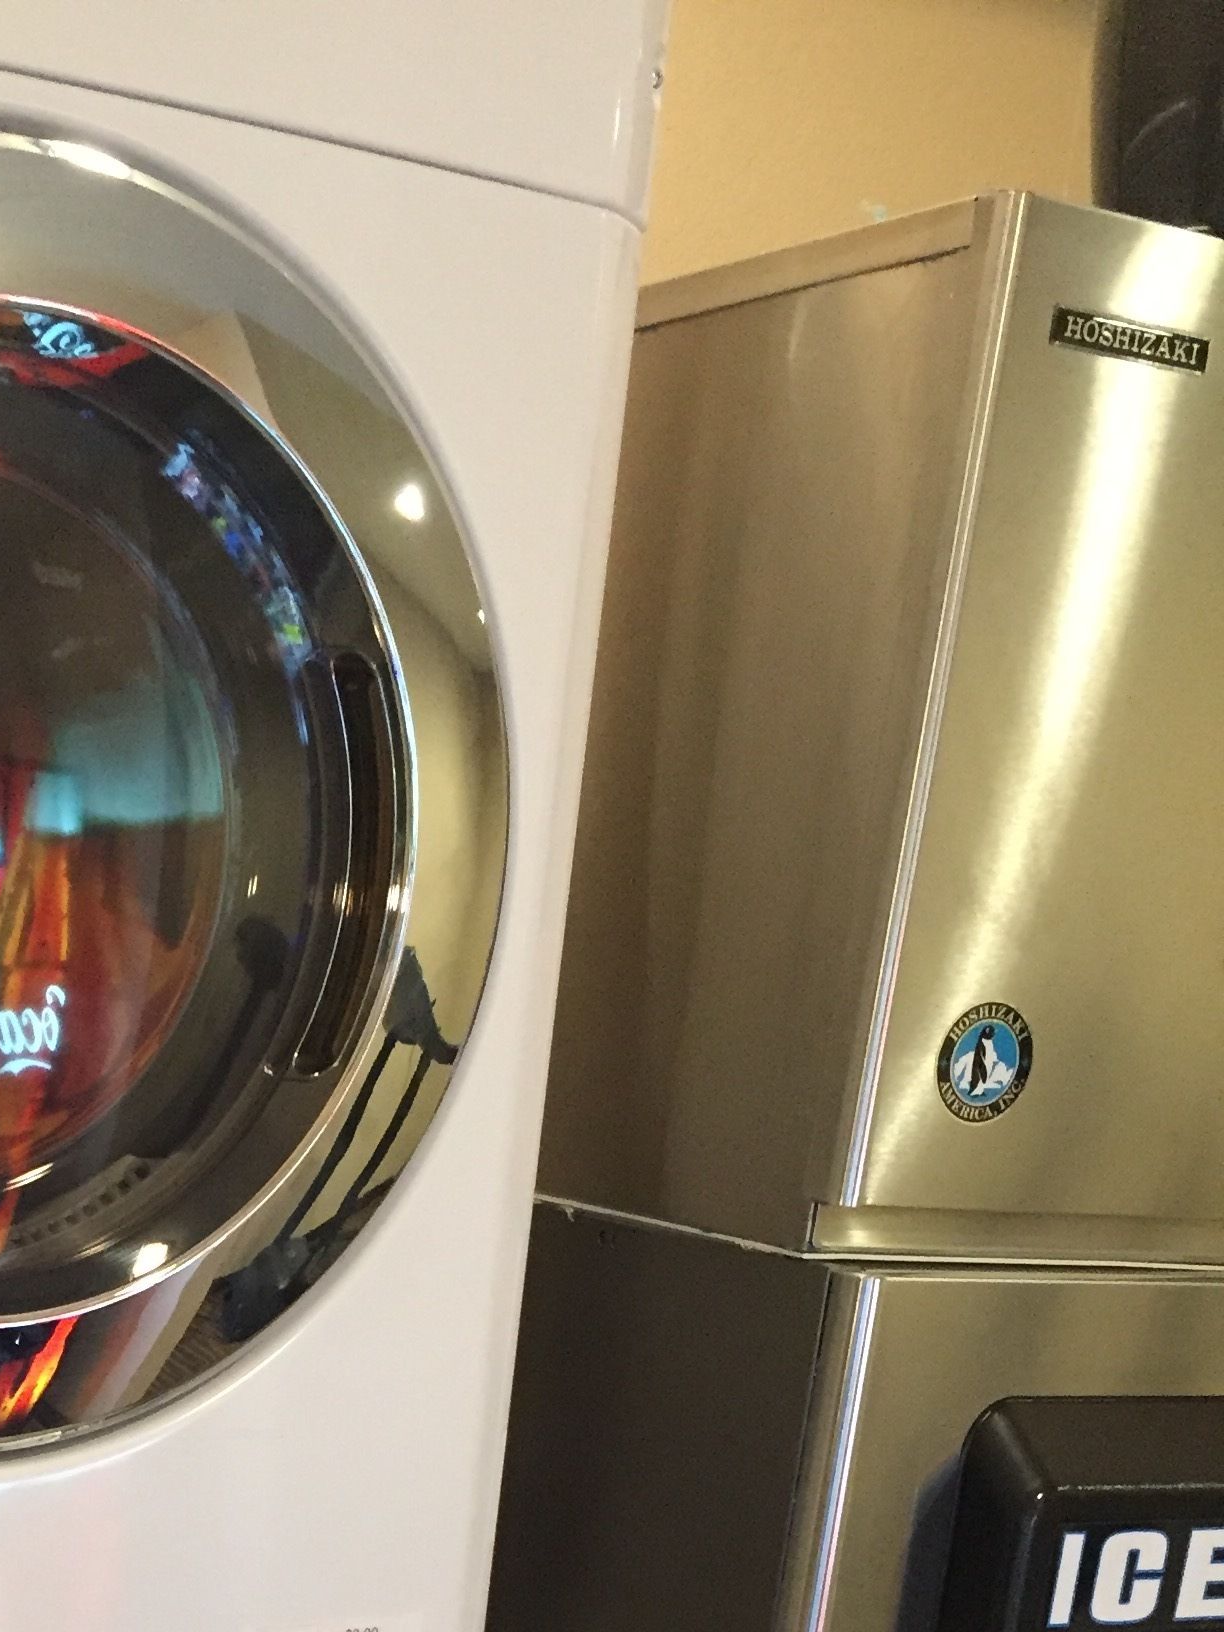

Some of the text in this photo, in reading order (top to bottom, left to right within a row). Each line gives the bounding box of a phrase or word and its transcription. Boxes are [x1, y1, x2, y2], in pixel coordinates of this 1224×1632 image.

[1063, 314, 1201, 366] HOSHIZAKI
[949, 1004, 1030, 1041] HOSHIZAKI
[1046, 1528, 1224, 1629] ICE
